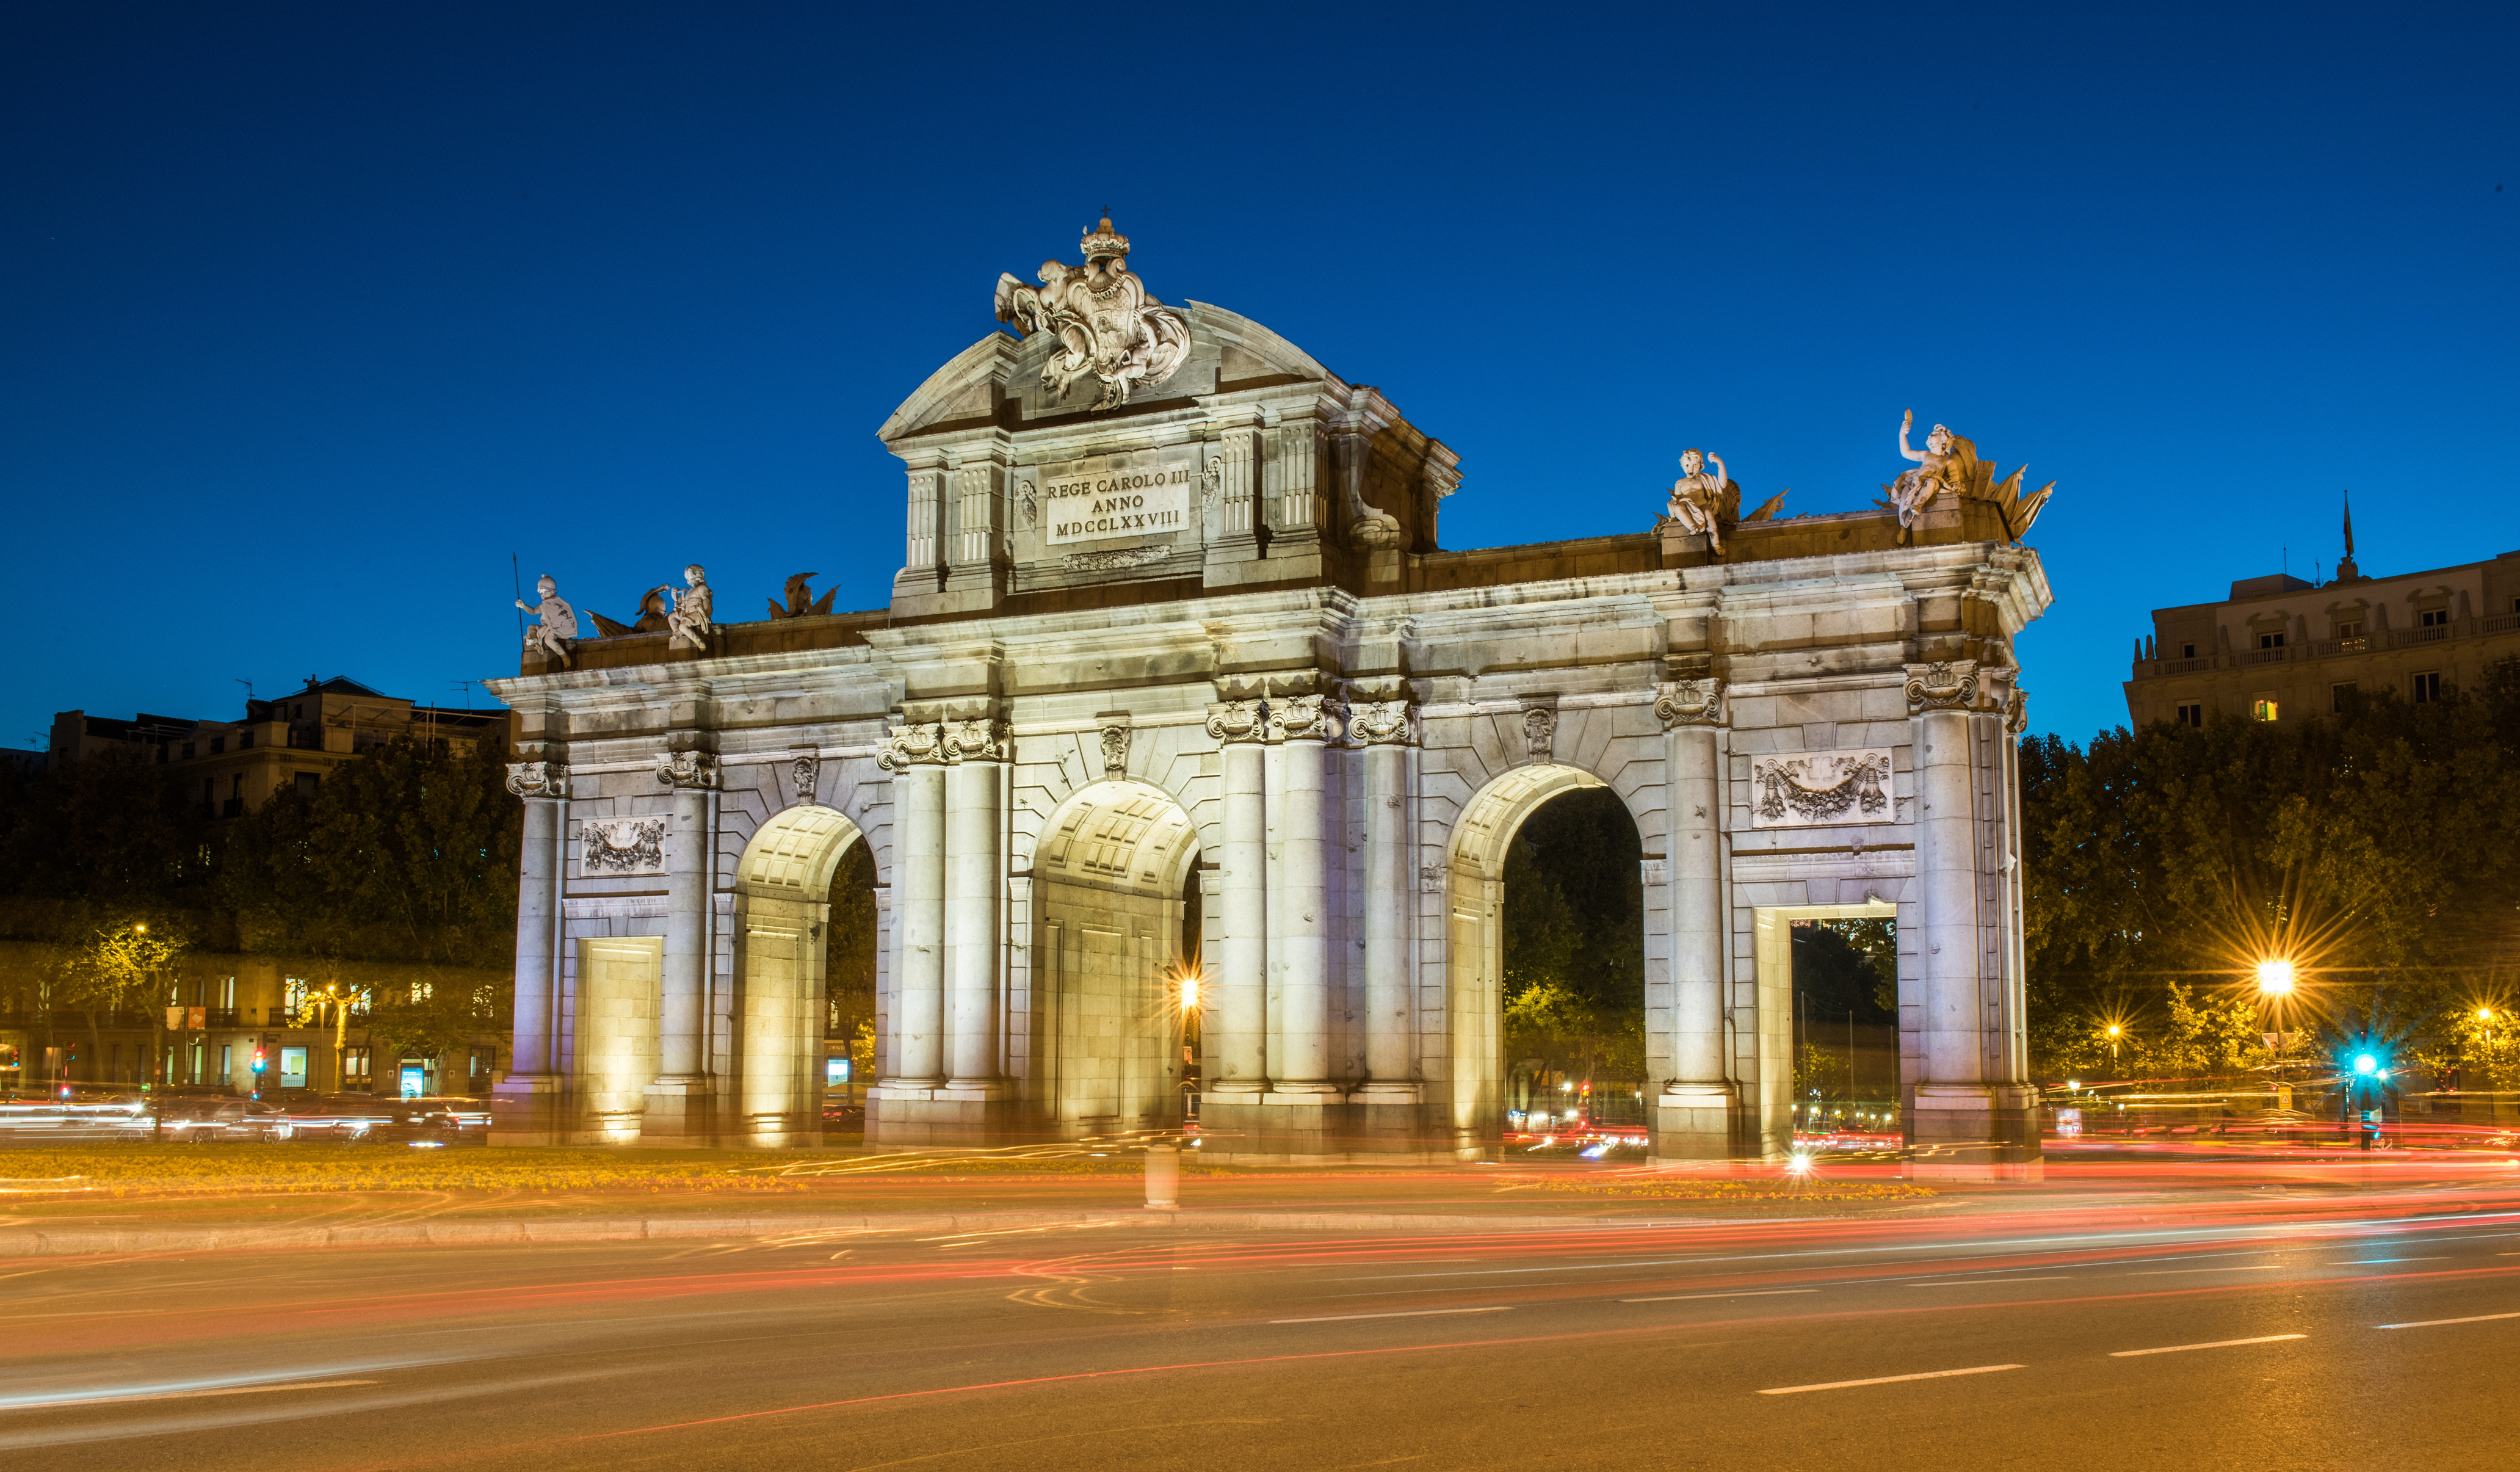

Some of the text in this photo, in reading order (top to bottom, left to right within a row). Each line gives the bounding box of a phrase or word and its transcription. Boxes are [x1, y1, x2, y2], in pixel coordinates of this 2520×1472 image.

[1048, 470, 1190, 499] REGE CAROLO III
[1092, 495, 1143, 513] ANNO
[1056, 510, 1179, 537] MDCCLXXVIII
